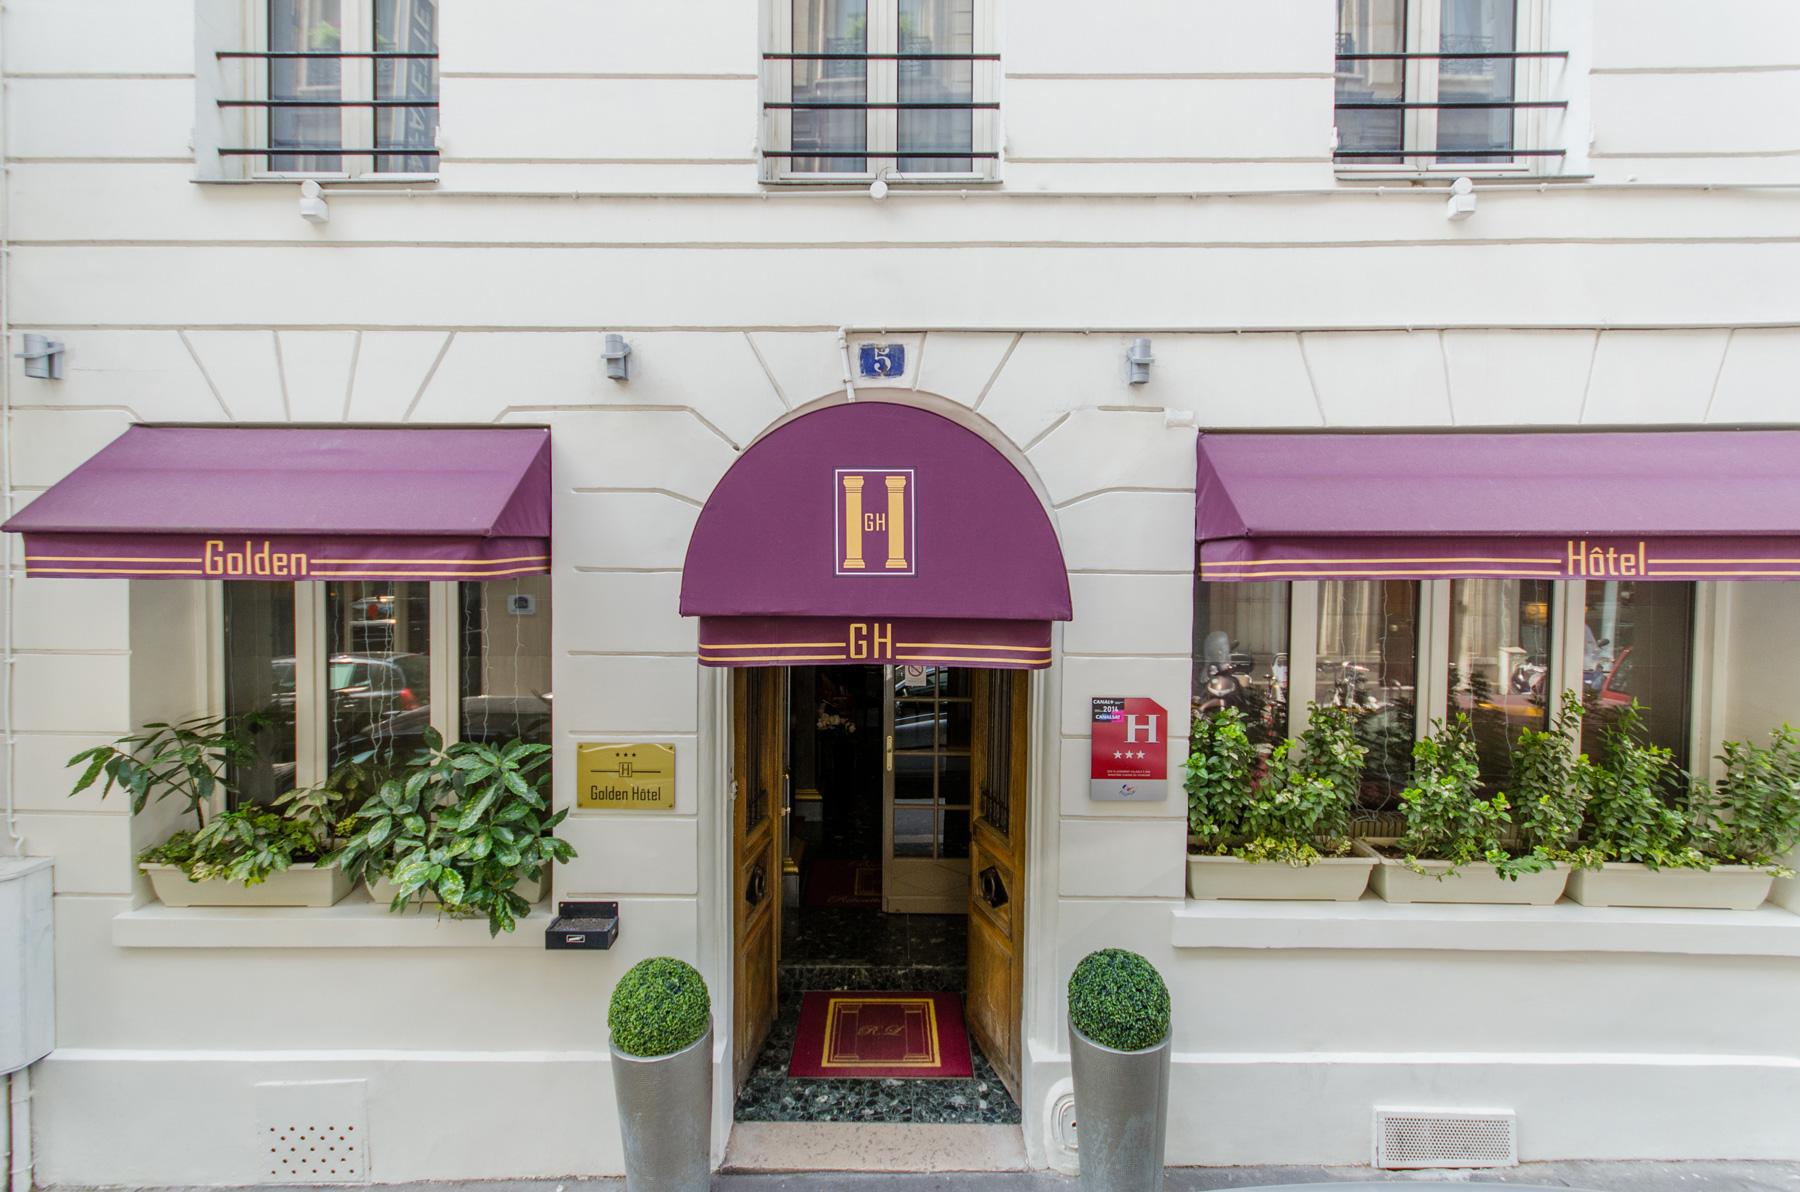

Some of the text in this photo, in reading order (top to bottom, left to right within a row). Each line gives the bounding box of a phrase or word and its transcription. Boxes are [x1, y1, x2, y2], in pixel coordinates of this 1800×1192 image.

[874, 347, 892, 373] 5
[864, 512, 886, 532] GH
[205, 540, 307, 576] Golden
[1568, 540, 1645, 576] Hôtel
[849, 623, 892, 659] GH
[1103, 705, 1119, 713] 2014
[1123, 714, 1161, 743] H
[590, 785, 661, 801] Golden Hôtel
